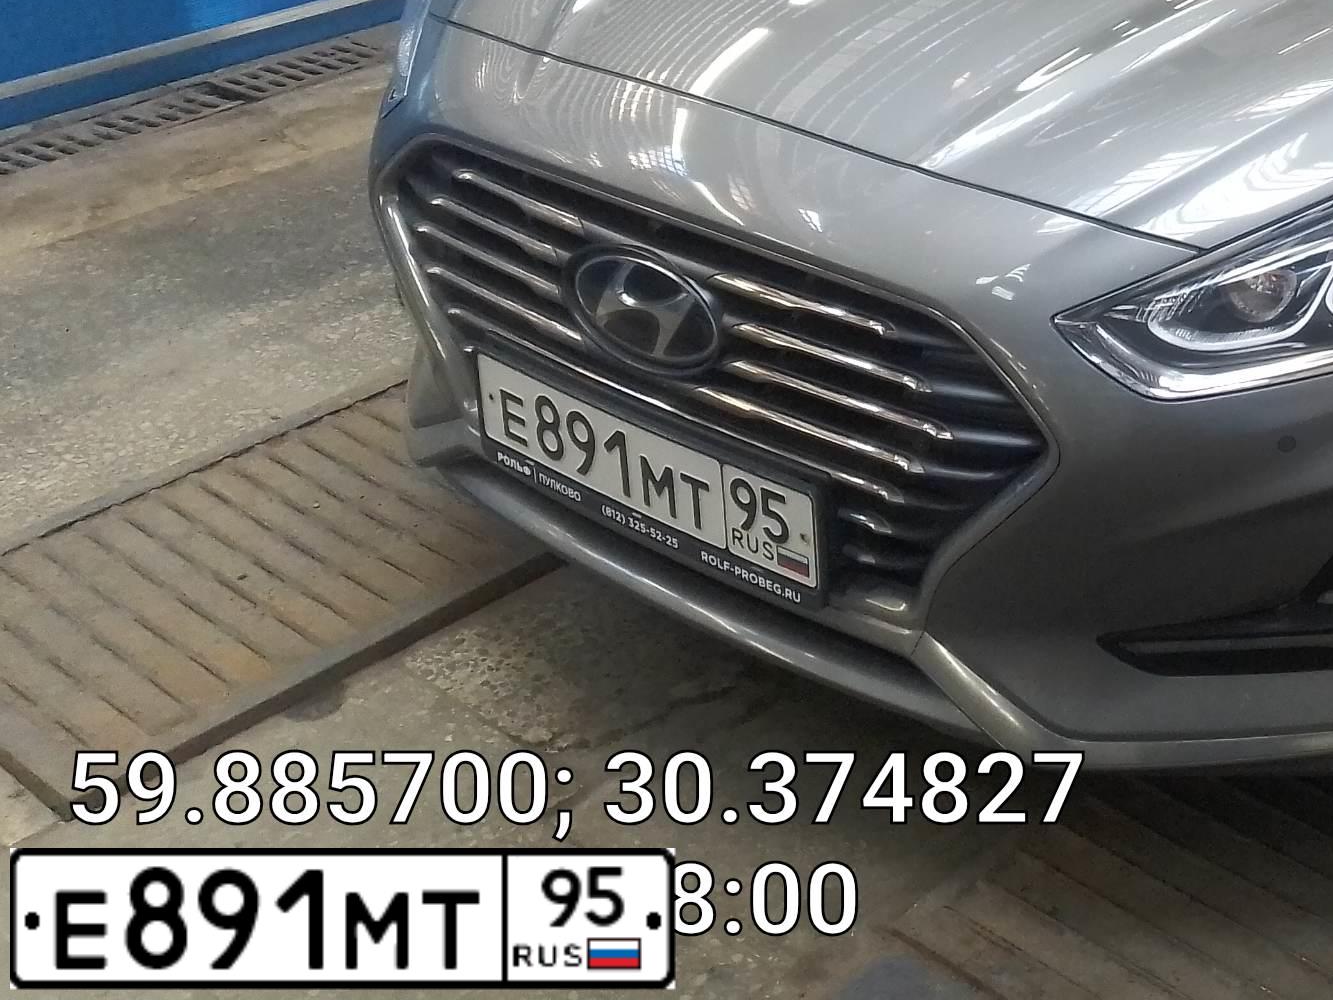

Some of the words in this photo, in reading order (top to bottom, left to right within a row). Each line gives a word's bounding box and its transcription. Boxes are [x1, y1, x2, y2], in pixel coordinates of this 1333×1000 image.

[497, 450, 532, 477] РОЛЬФ
[539, 471, 581, 502] ПУЛКОВО
[628, 514, 679, 549] 325-52-25
[729, 477, 790, 544] 95
[732, 526, 775, 562] RUS
[700, 551, 801, 603] ROLF-PROBEG.RU
